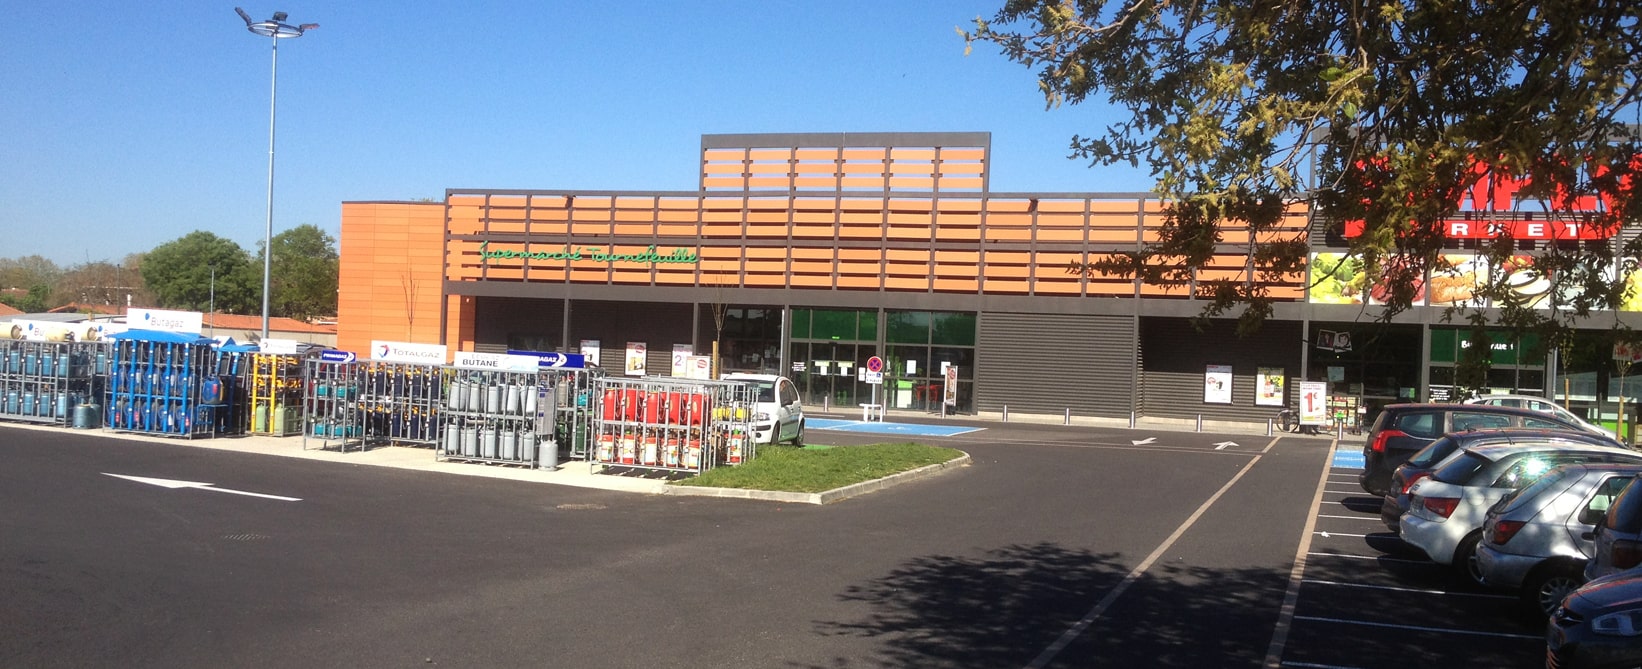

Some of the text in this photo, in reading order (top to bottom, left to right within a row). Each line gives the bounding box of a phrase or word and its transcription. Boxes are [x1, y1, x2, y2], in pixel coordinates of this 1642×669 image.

[480, 240, 697, 267] Supermarché Tournefeuille
[151, 317, 184, 329] Butagaz
[462, 358, 498, 368] BUTANE
